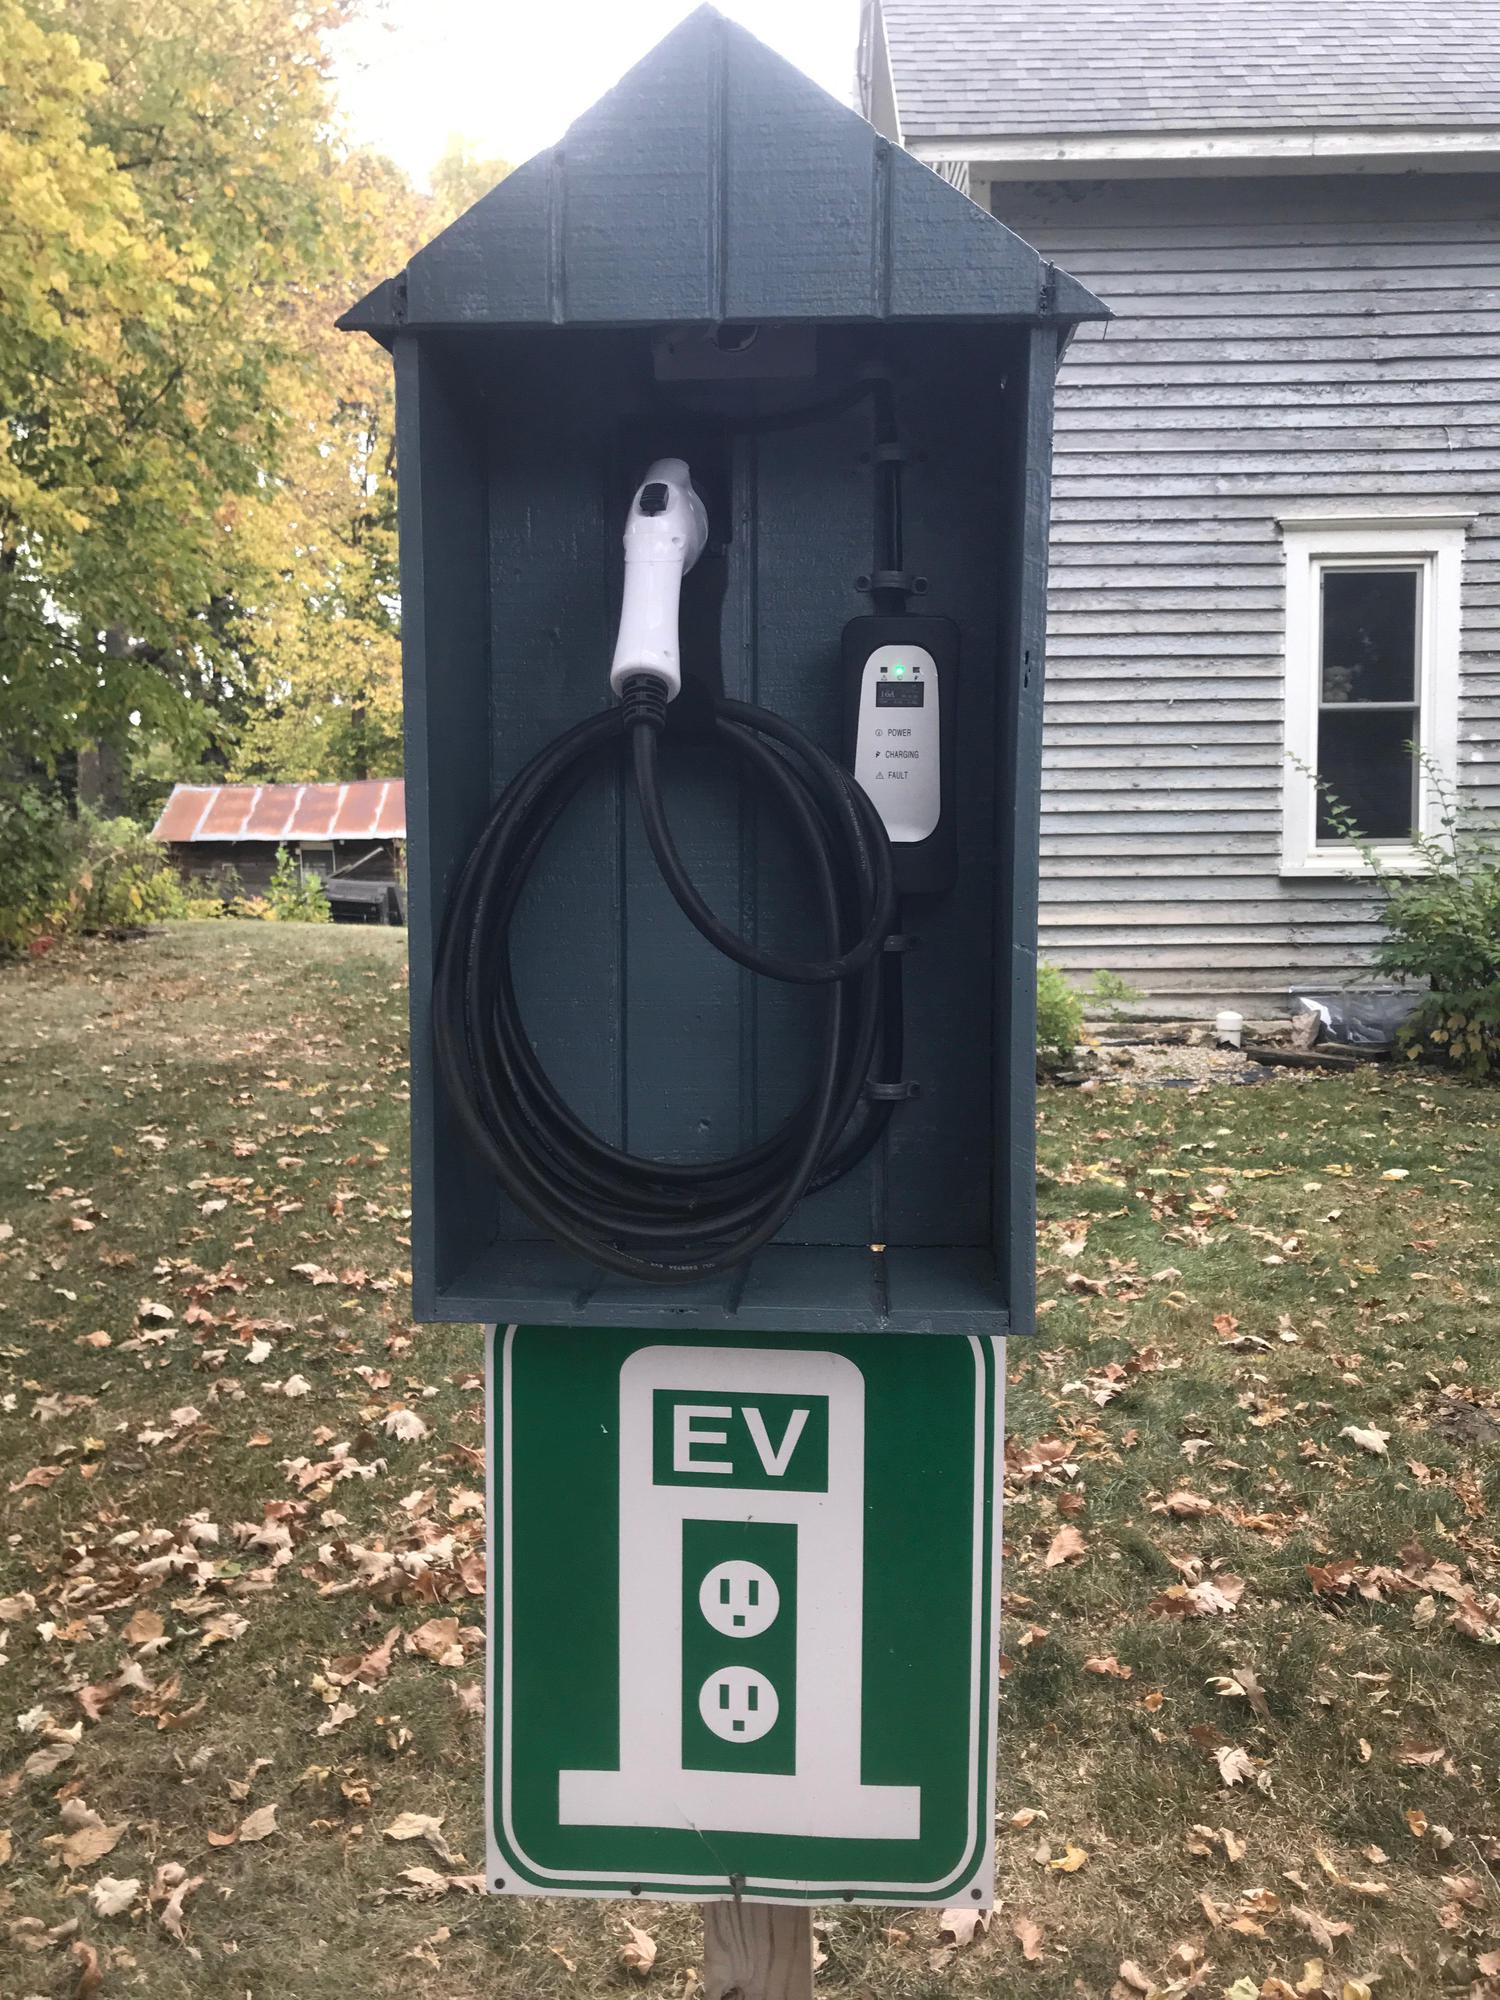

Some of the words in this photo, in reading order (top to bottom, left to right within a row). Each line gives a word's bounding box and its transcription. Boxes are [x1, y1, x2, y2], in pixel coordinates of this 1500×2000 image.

[887, 728, 912, 737] POWER
[885, 750, 920, 759] CHARGING
[888, 771, 909, 780] FAULT
[673, 1404, 810, 1476] EV
